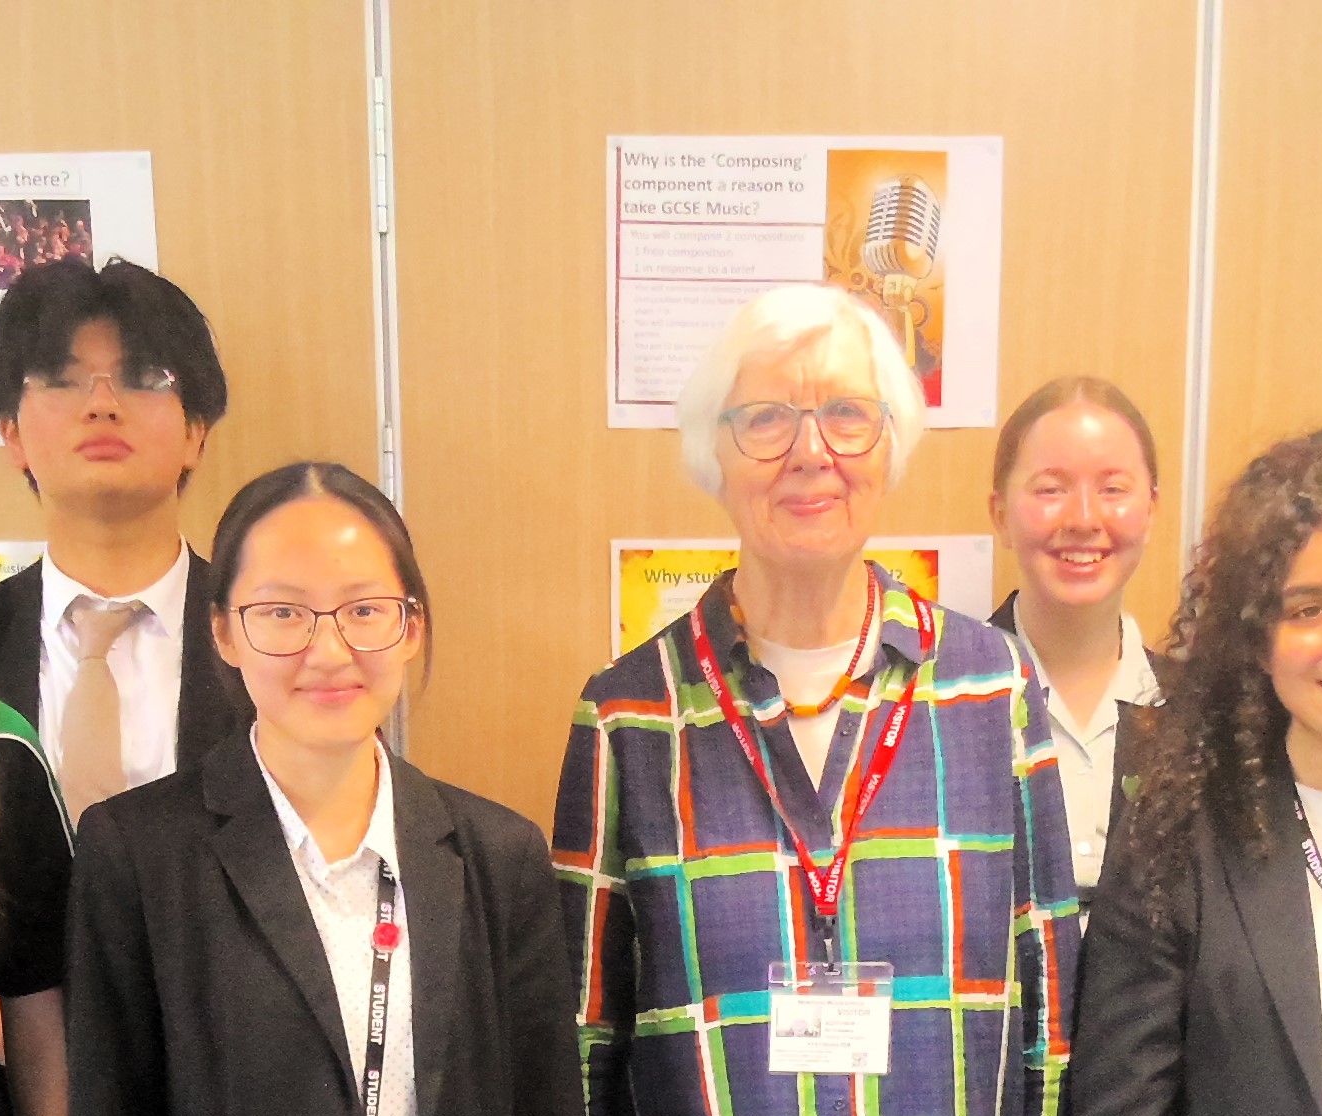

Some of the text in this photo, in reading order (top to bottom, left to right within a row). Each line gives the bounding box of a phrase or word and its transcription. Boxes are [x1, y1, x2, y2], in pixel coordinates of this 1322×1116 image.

[623, 153, 659, 169] Why
[664, 153, 675, 167] is
[681, 153, 706, 168] the
[14, 170, 70, 188] there?
[624, 180, 805, 193] component a reason to
[623, 201, 761, 215] take GCSE Music?
[673, 232, 722, 242] compose
[643, 568, 682, 587] Why
[700, 656, 723, 698] VISITOR
[883, 705, 907, 747] VISITOR
[731, 722, 755, 765] VISITOR
[857, 774, 882, 816] VISITOR
[824, 857, 845, 903] VISITOR
[371, 984, 386, 1046] STUDENT
[837, 1008, 871, 1016] VISITOR
